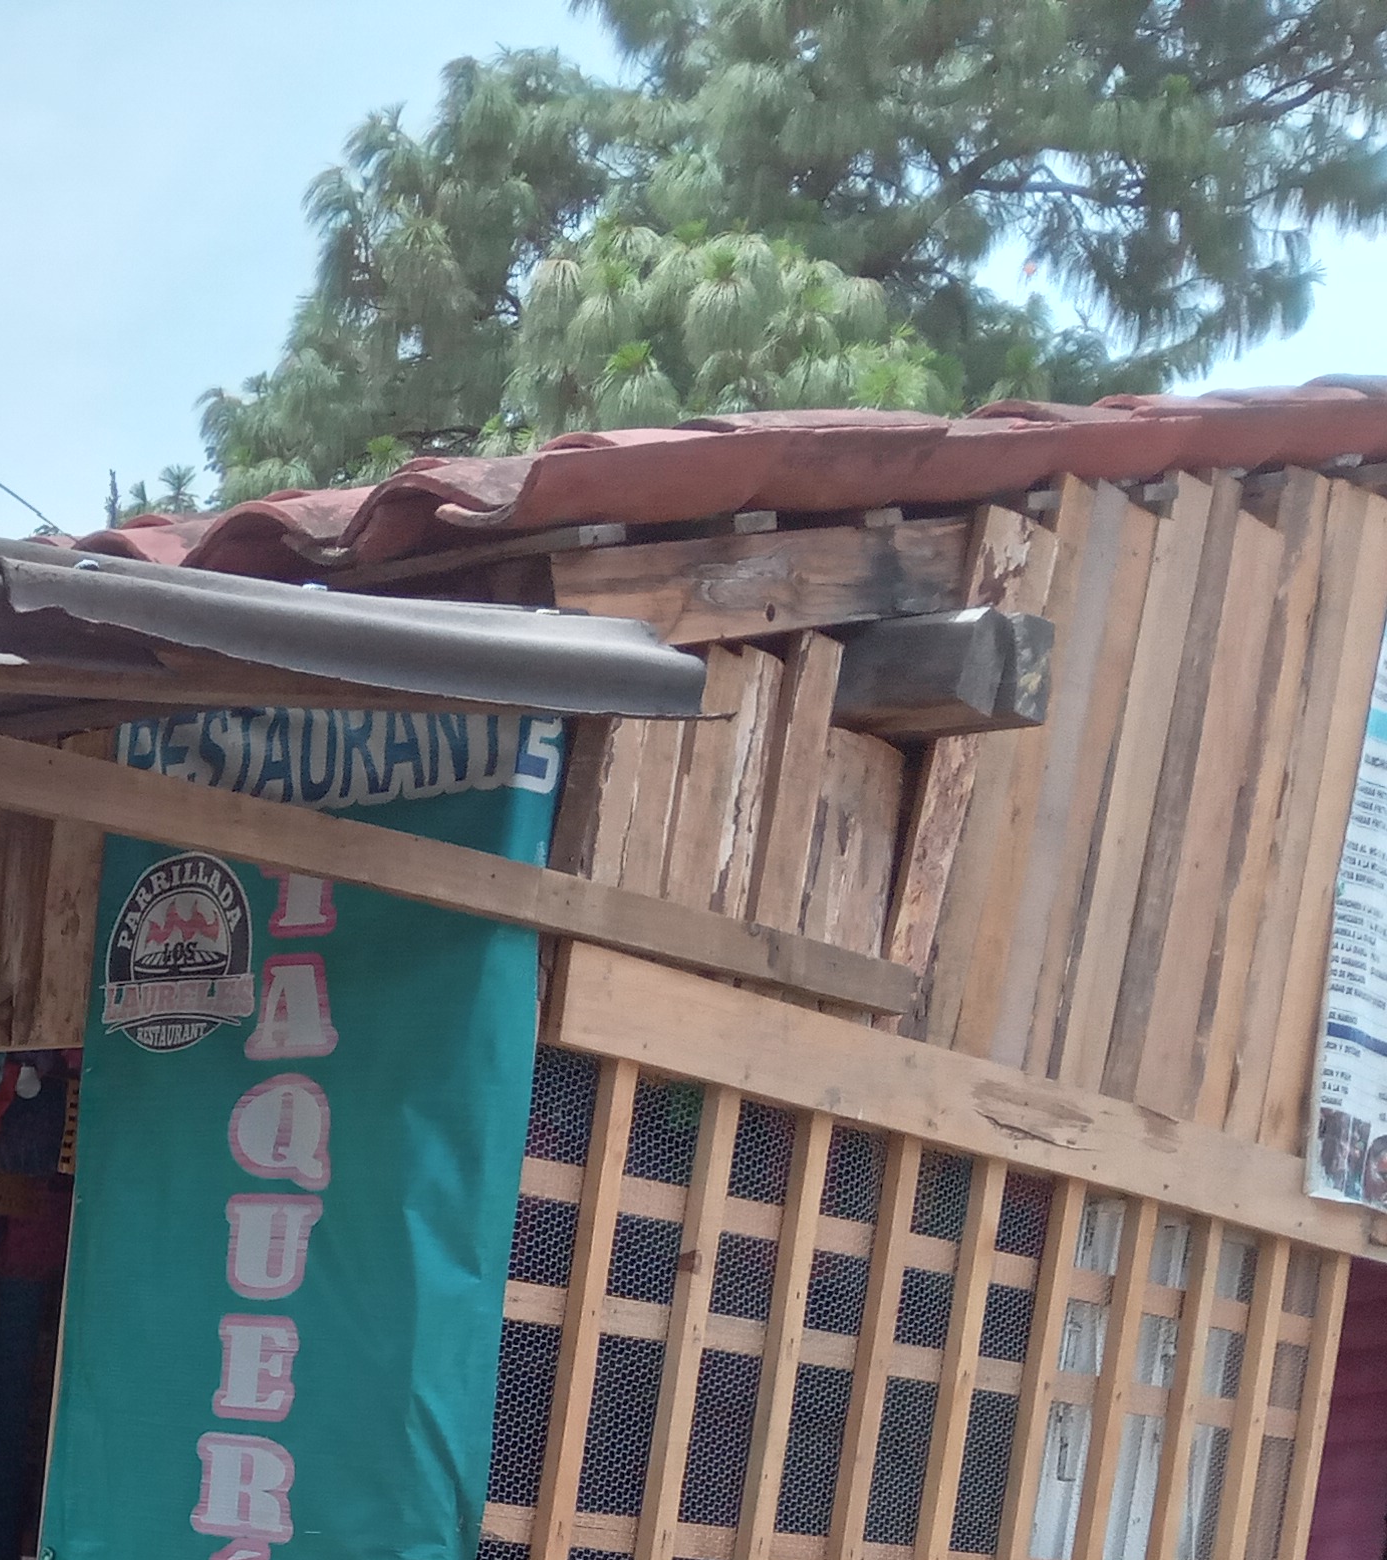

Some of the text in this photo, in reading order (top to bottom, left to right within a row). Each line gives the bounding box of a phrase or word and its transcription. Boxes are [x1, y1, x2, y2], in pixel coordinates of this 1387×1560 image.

[117, 862, 243, 950] PARRILLADA
[163, 941, 198, 966] LOS
[103, 976, 255, 1022] LAURELES
[136, 1022, 207, 1048] RESTAURANT
